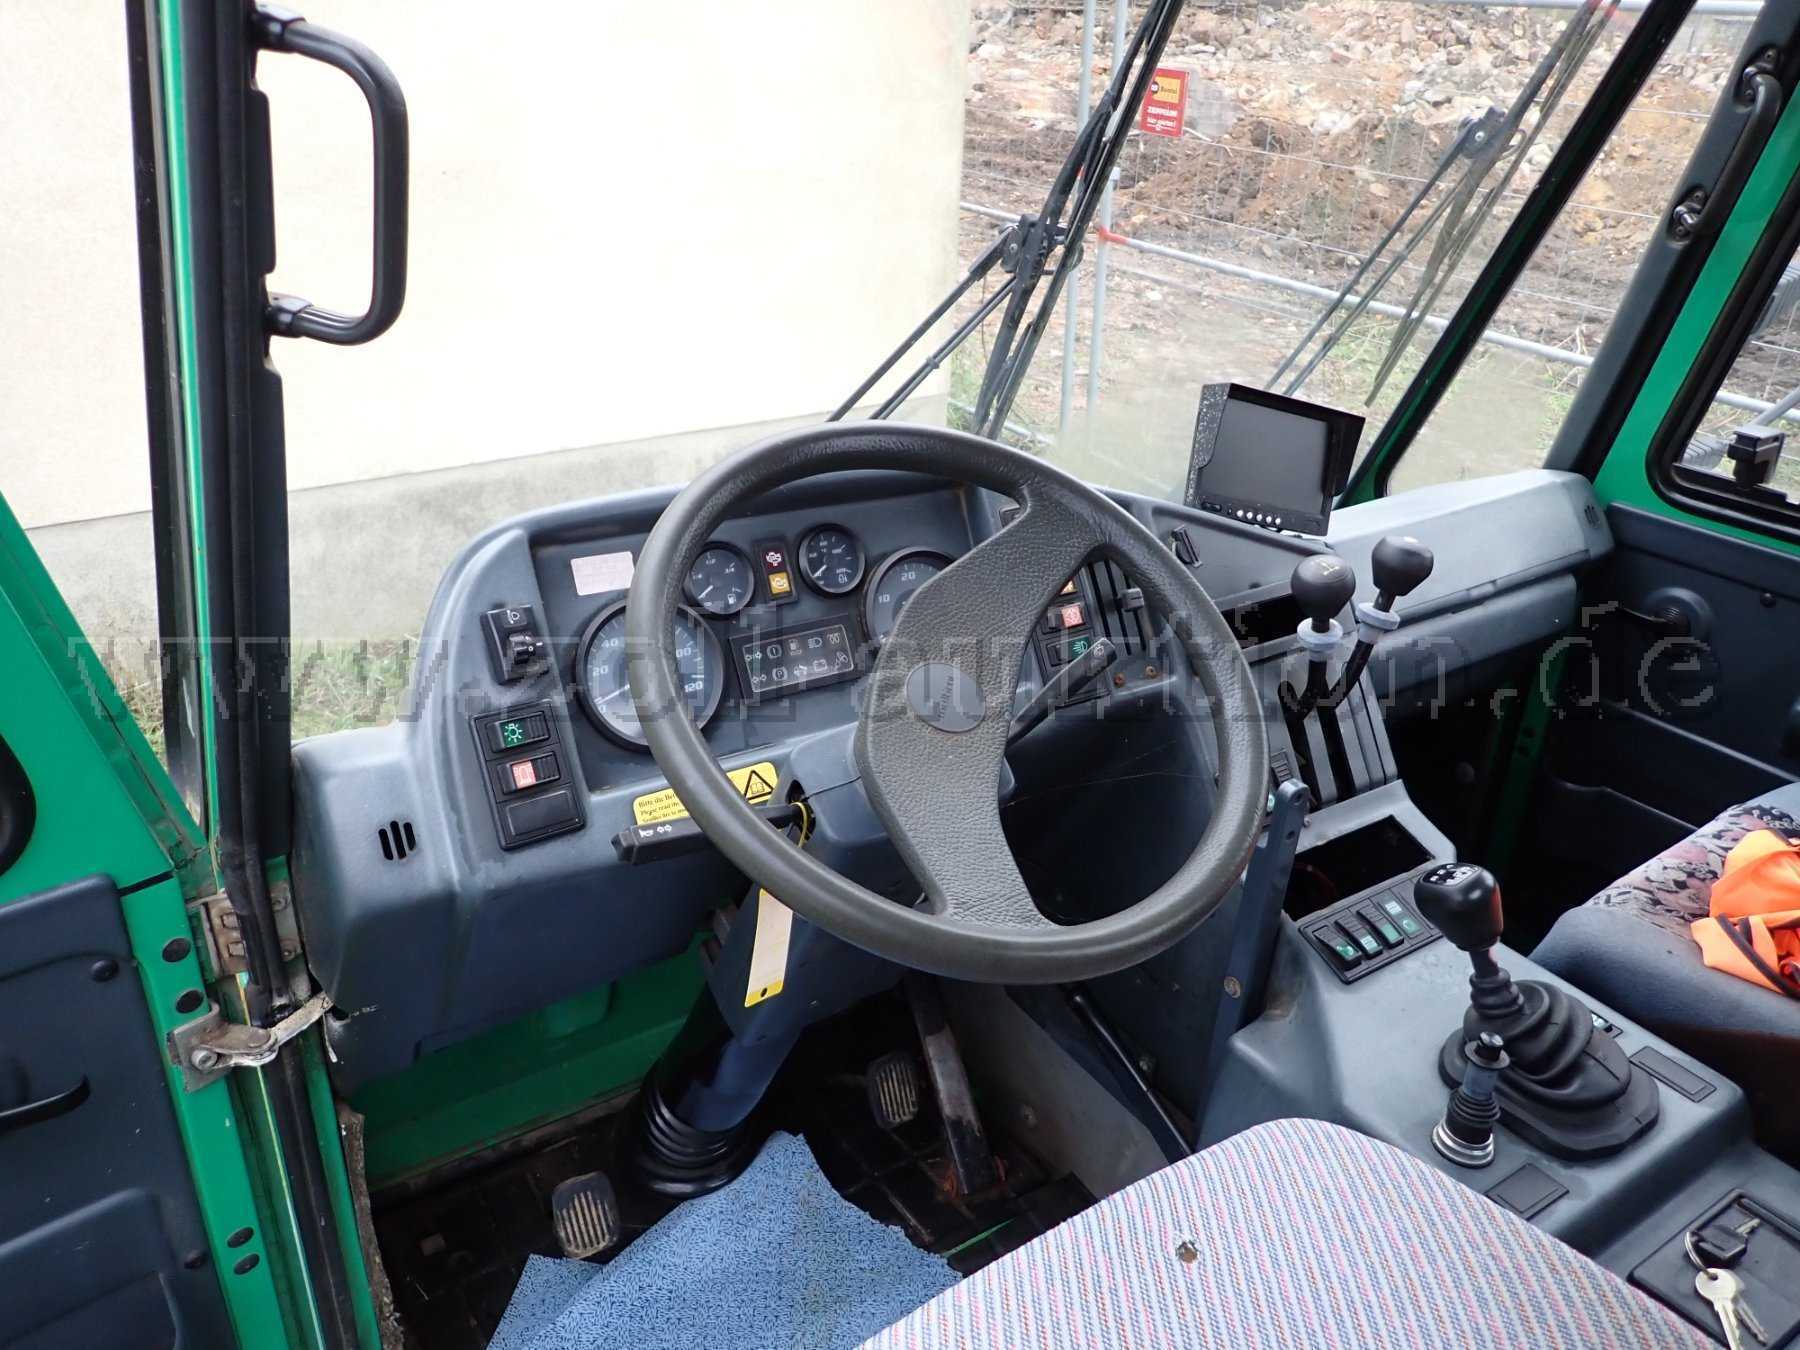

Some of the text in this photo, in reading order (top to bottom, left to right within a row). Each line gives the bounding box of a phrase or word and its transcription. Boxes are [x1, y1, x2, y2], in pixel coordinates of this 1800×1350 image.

[901, 570, 916, 581] 20
[878, 593, 891, 604] 10
[600, 637, 618, 649] 40
[592, 664, 608, 677] 20
[684, 680, 703, 693] 120
